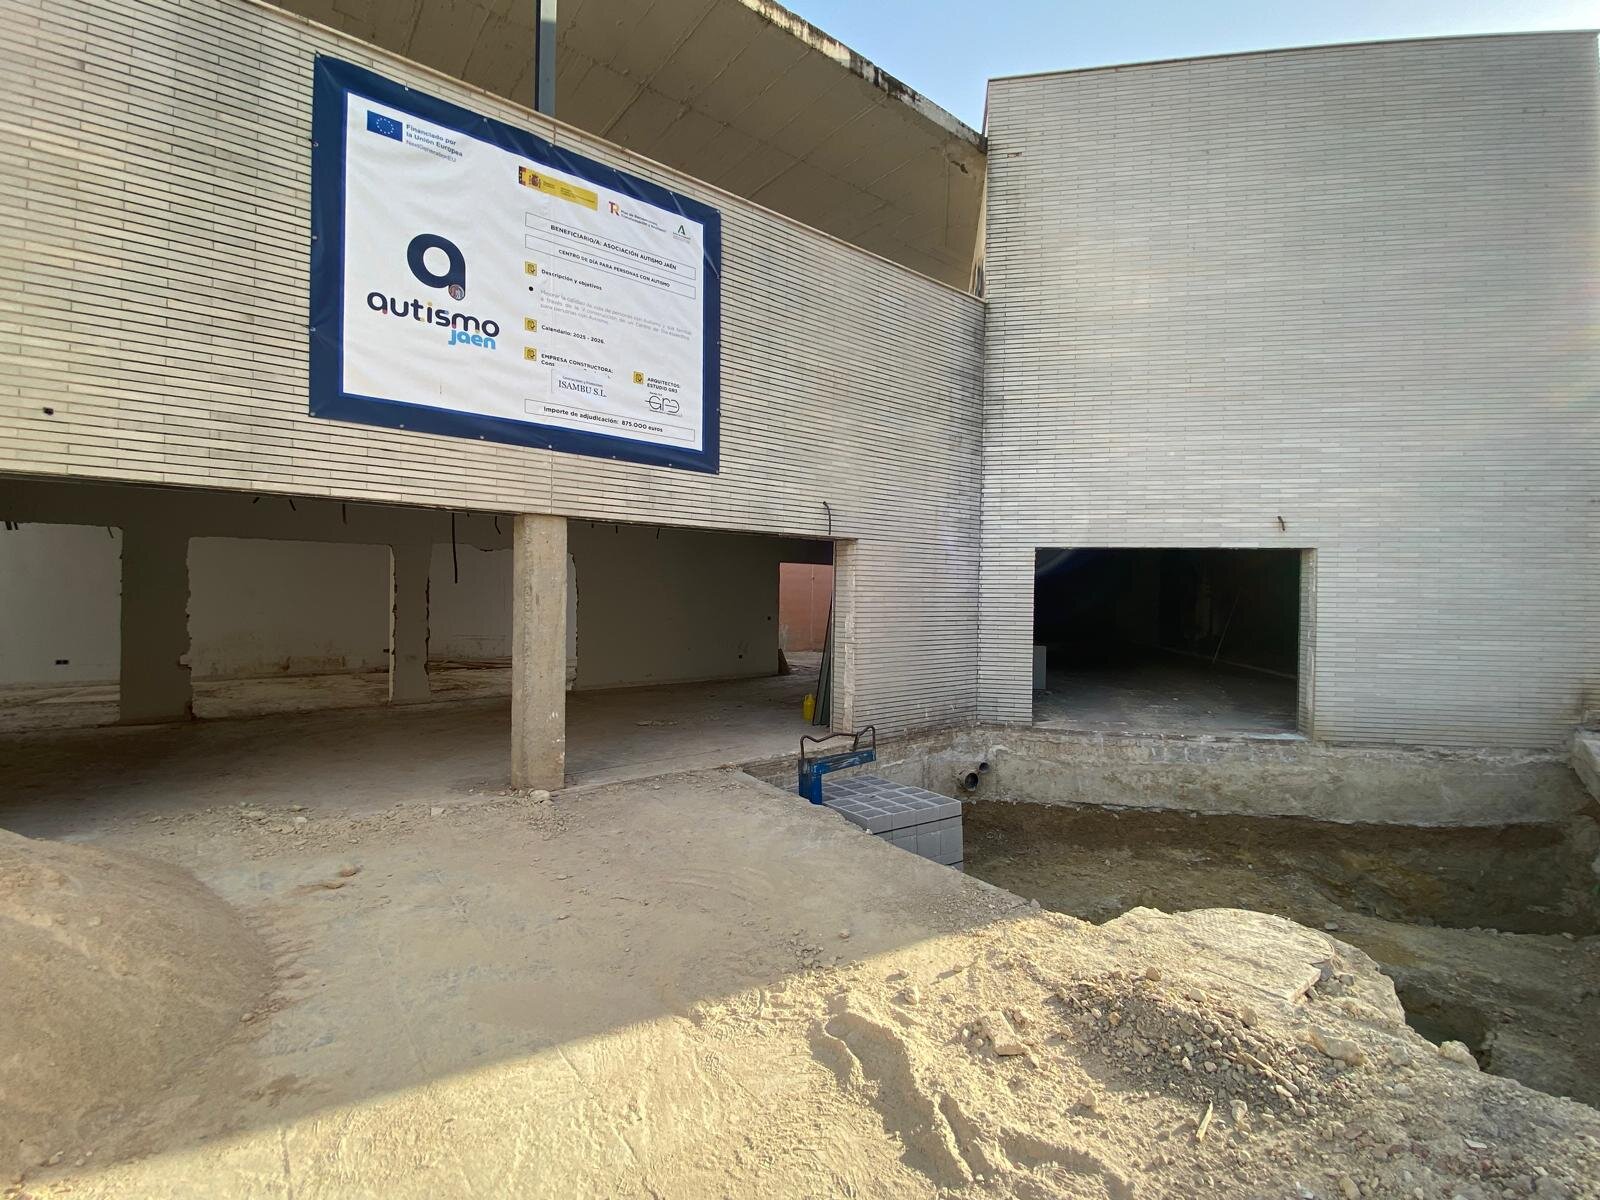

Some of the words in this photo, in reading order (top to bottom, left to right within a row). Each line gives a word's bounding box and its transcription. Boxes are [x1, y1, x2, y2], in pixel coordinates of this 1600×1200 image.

[406, 124, 444, 141] Financiado
[445, 138, 457, 146] por
[414, 133, 435, 145] Unión
[436, 141, 463, 157] Europea
[550, 224, 602, 247] BENEFICIARIO/A:
[603, 241, 639, 258] ASOCIACIÓN
[640, 254, 663, 266] AUTISMO
[663, 261, 677, 271] JAÉN
[541, 268, 573, 283] Descripción
[578, 280, 602, 291] objetivos
[558, 249, 581, 260] CENTRO
[599, 261, 613, 270] PARA
[613, 266, 639, 278] PERSONAS
[639, 274, 651, 282] CON
[651, 278, 671, 288] AUTISMO
[366, 291, 500, 338] autismo
[541, 324, 572, 337] Calendario:
[573, 332, 586, 340] 2025
[541, 353, 568, 364] EMPRESA
[568, 359, 614, 374] CONSTRUCTORA:
[558, 379, 592, 395] ISAMBU
[593, 389, 607, 398] S.L.
[646, 383, 668, 392] ESTUDIO
[543, 406, 569, 417] Importe
[579, 413, 619, 425] adjudicación:
[621, 420, 648, 430] 875.000
[648, 425, 663, 433] euros
